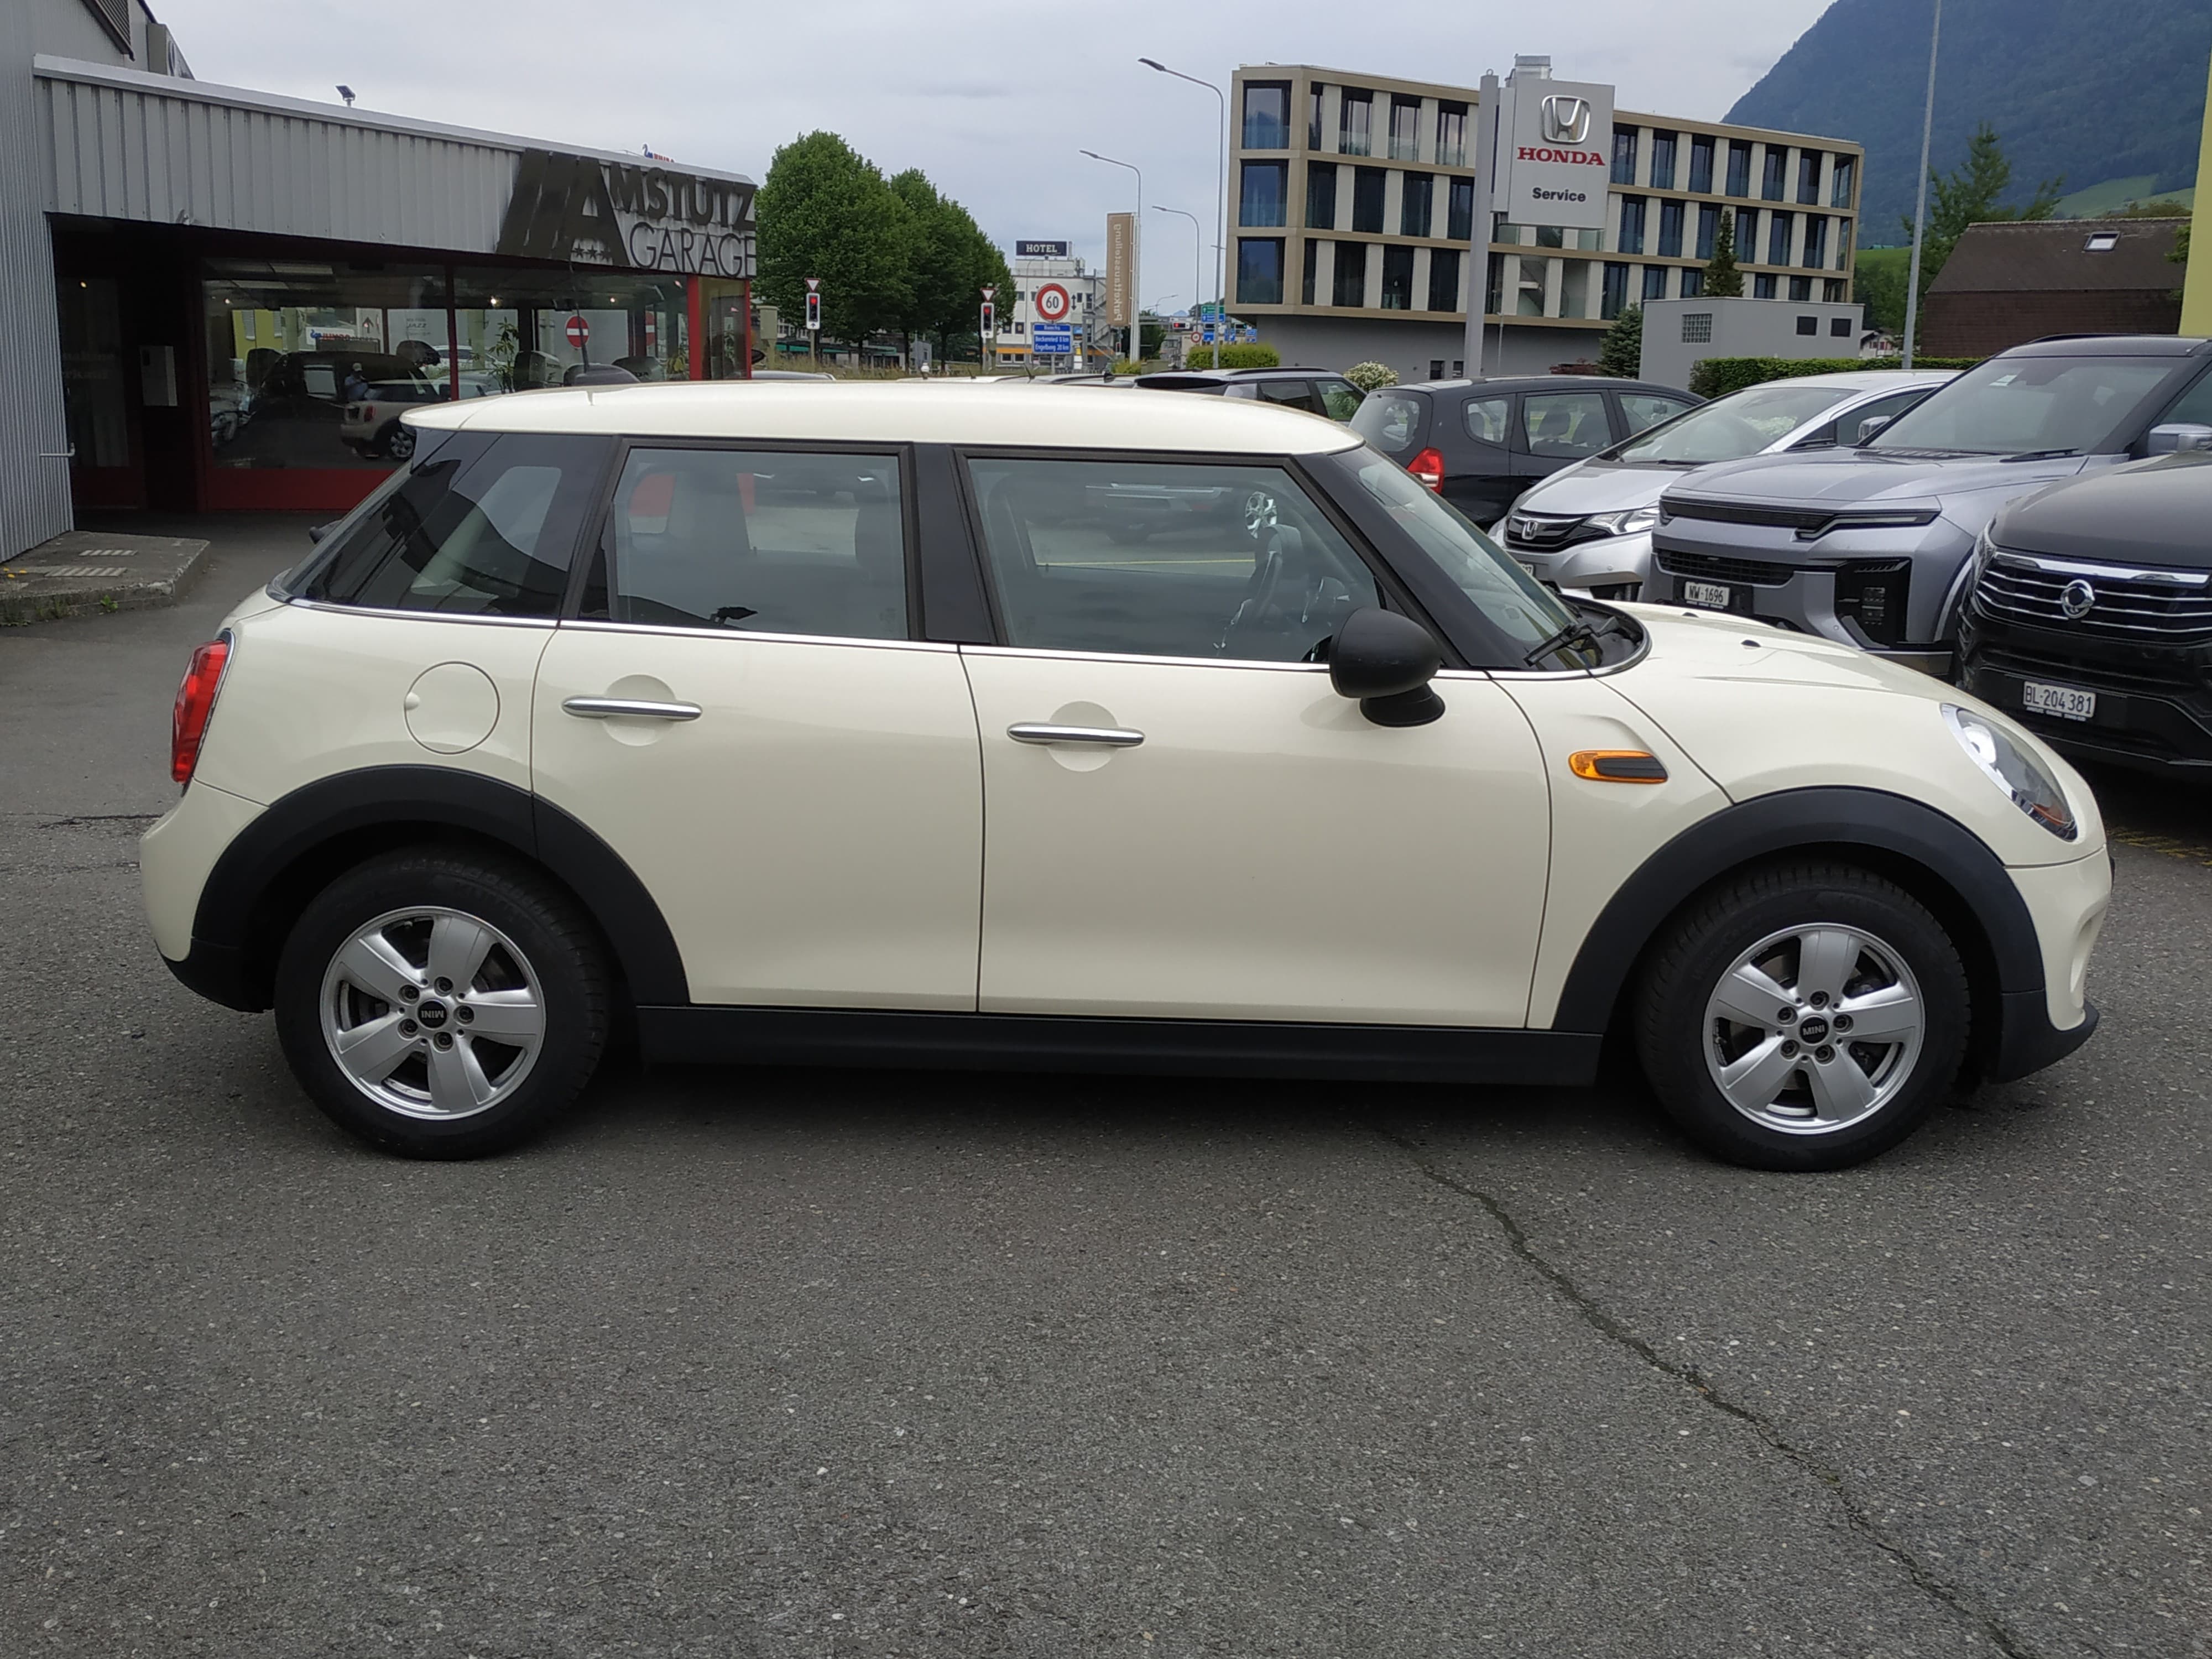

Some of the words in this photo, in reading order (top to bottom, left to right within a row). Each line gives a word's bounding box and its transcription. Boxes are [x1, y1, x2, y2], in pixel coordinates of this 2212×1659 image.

[1517, 146, 1606, 166] HONDA
[1532, 187, 1587, 202] Service
[553, 155, 756, 267] AMSTUTZ
[629, 222, 757, 278] GARAGE
[1026, 244, 1057, 253] HOTEL
[1046, 296, 1059, 309] 60
[421, 1010, 444, 1019] MINI
[1803, 1024, 1825, 1035] MINI
